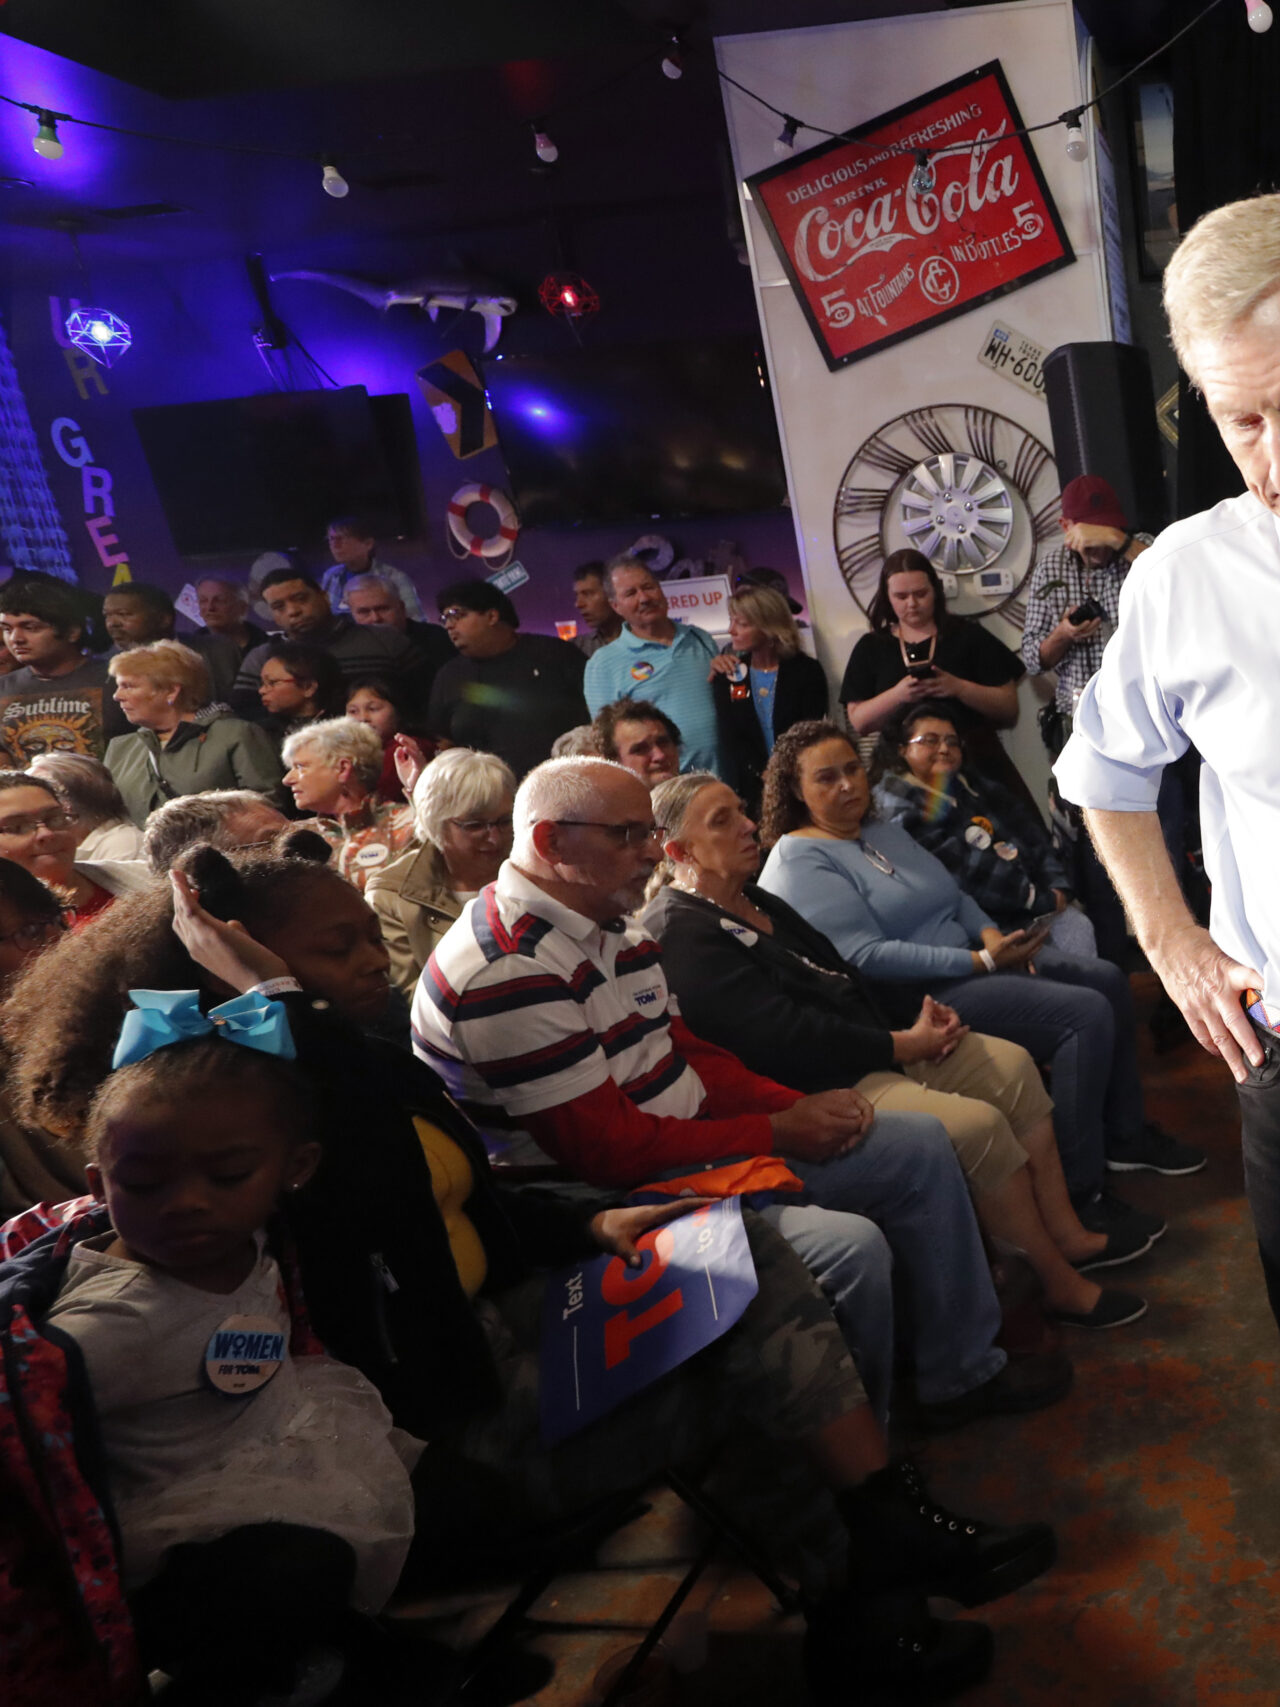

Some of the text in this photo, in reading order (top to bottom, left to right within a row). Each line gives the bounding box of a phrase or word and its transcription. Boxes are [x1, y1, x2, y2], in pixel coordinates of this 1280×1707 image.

[786, 103, 984, 205] DELICIOUS AND REFRESHING
[833, 176, 888, 208] DRINK
[702, 591, 723, 607] UP
[2, 697, 91, 721] Sublime
[634, 991, 657, 1006] TOM
[563, 1271, 584, 1320] Text
[214, 1332, 284, 1359] WOMEN
